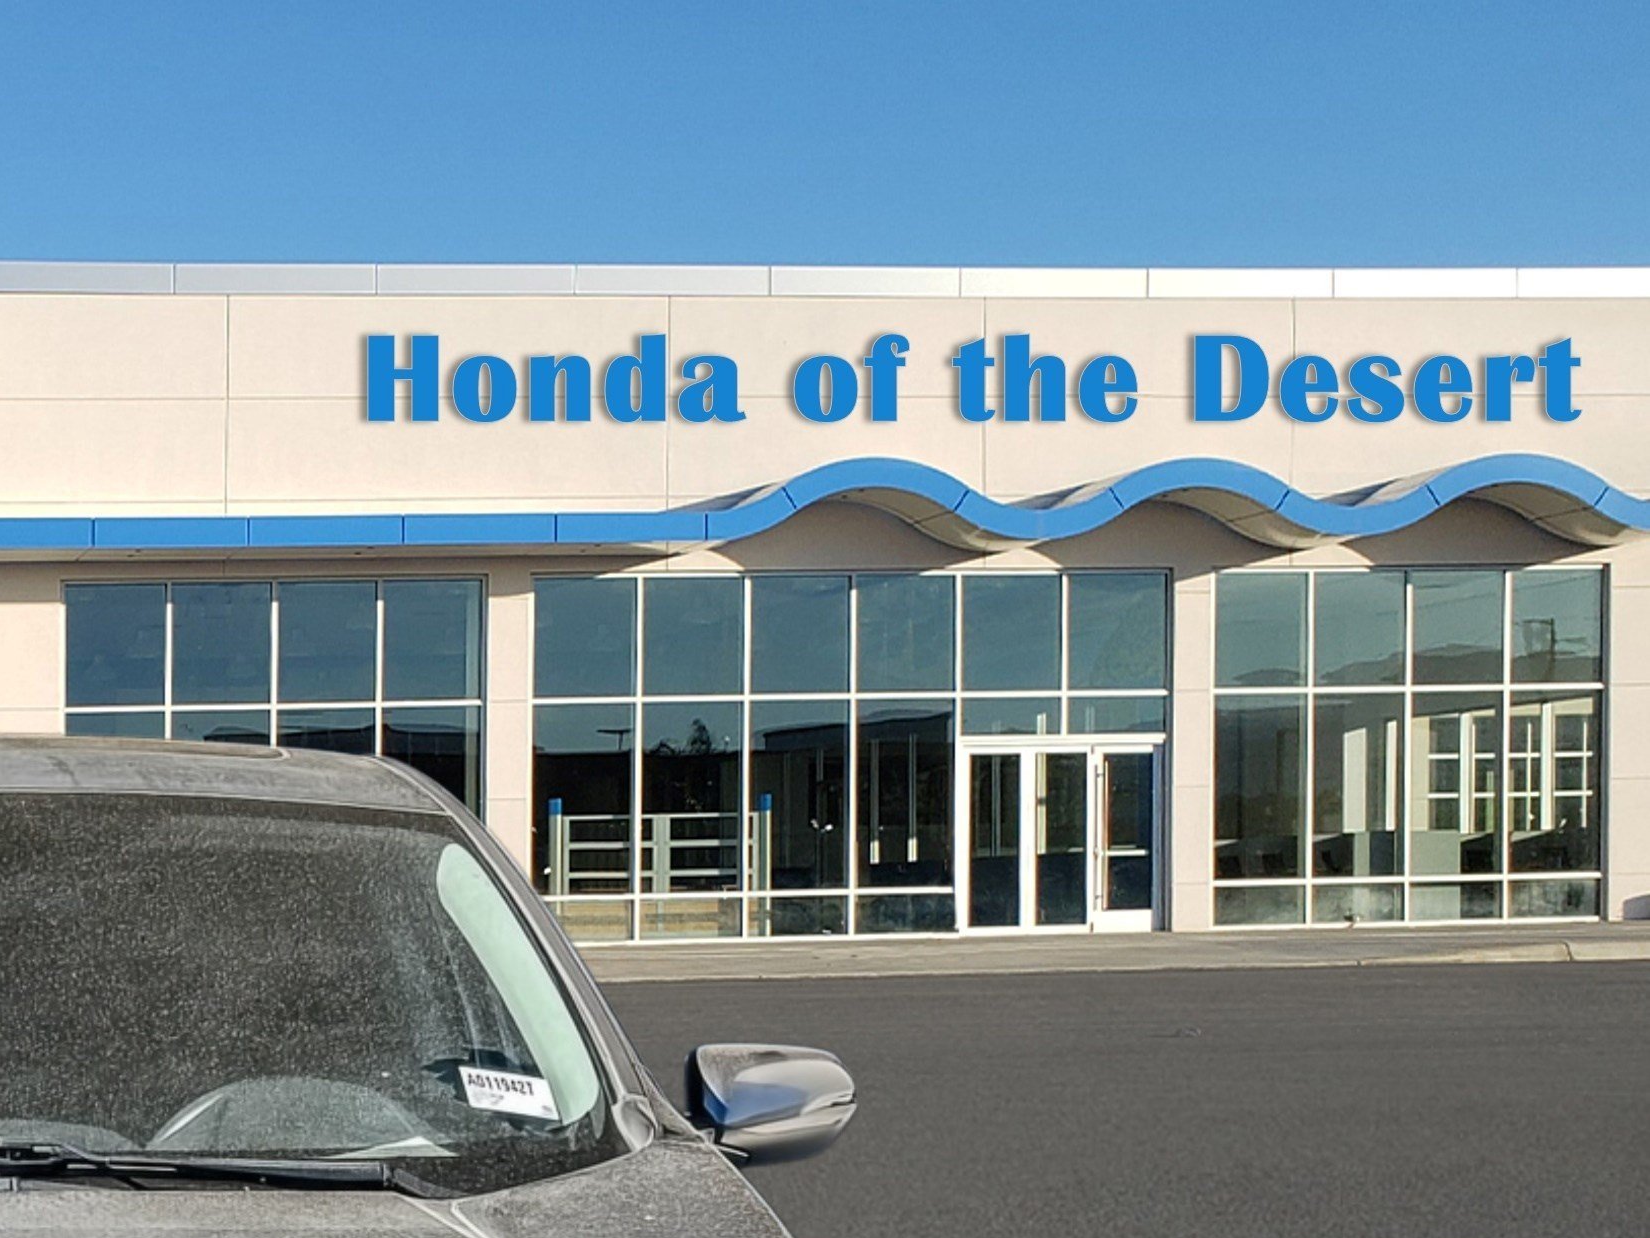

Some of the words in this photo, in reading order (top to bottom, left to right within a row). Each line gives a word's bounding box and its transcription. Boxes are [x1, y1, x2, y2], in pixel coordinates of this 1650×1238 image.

[366, 332, 748, 424] Honda
[792, 332, 912, 424] of
[950, 332, 1139, 424] the
[1192, 333, 1583, 424] Desert
